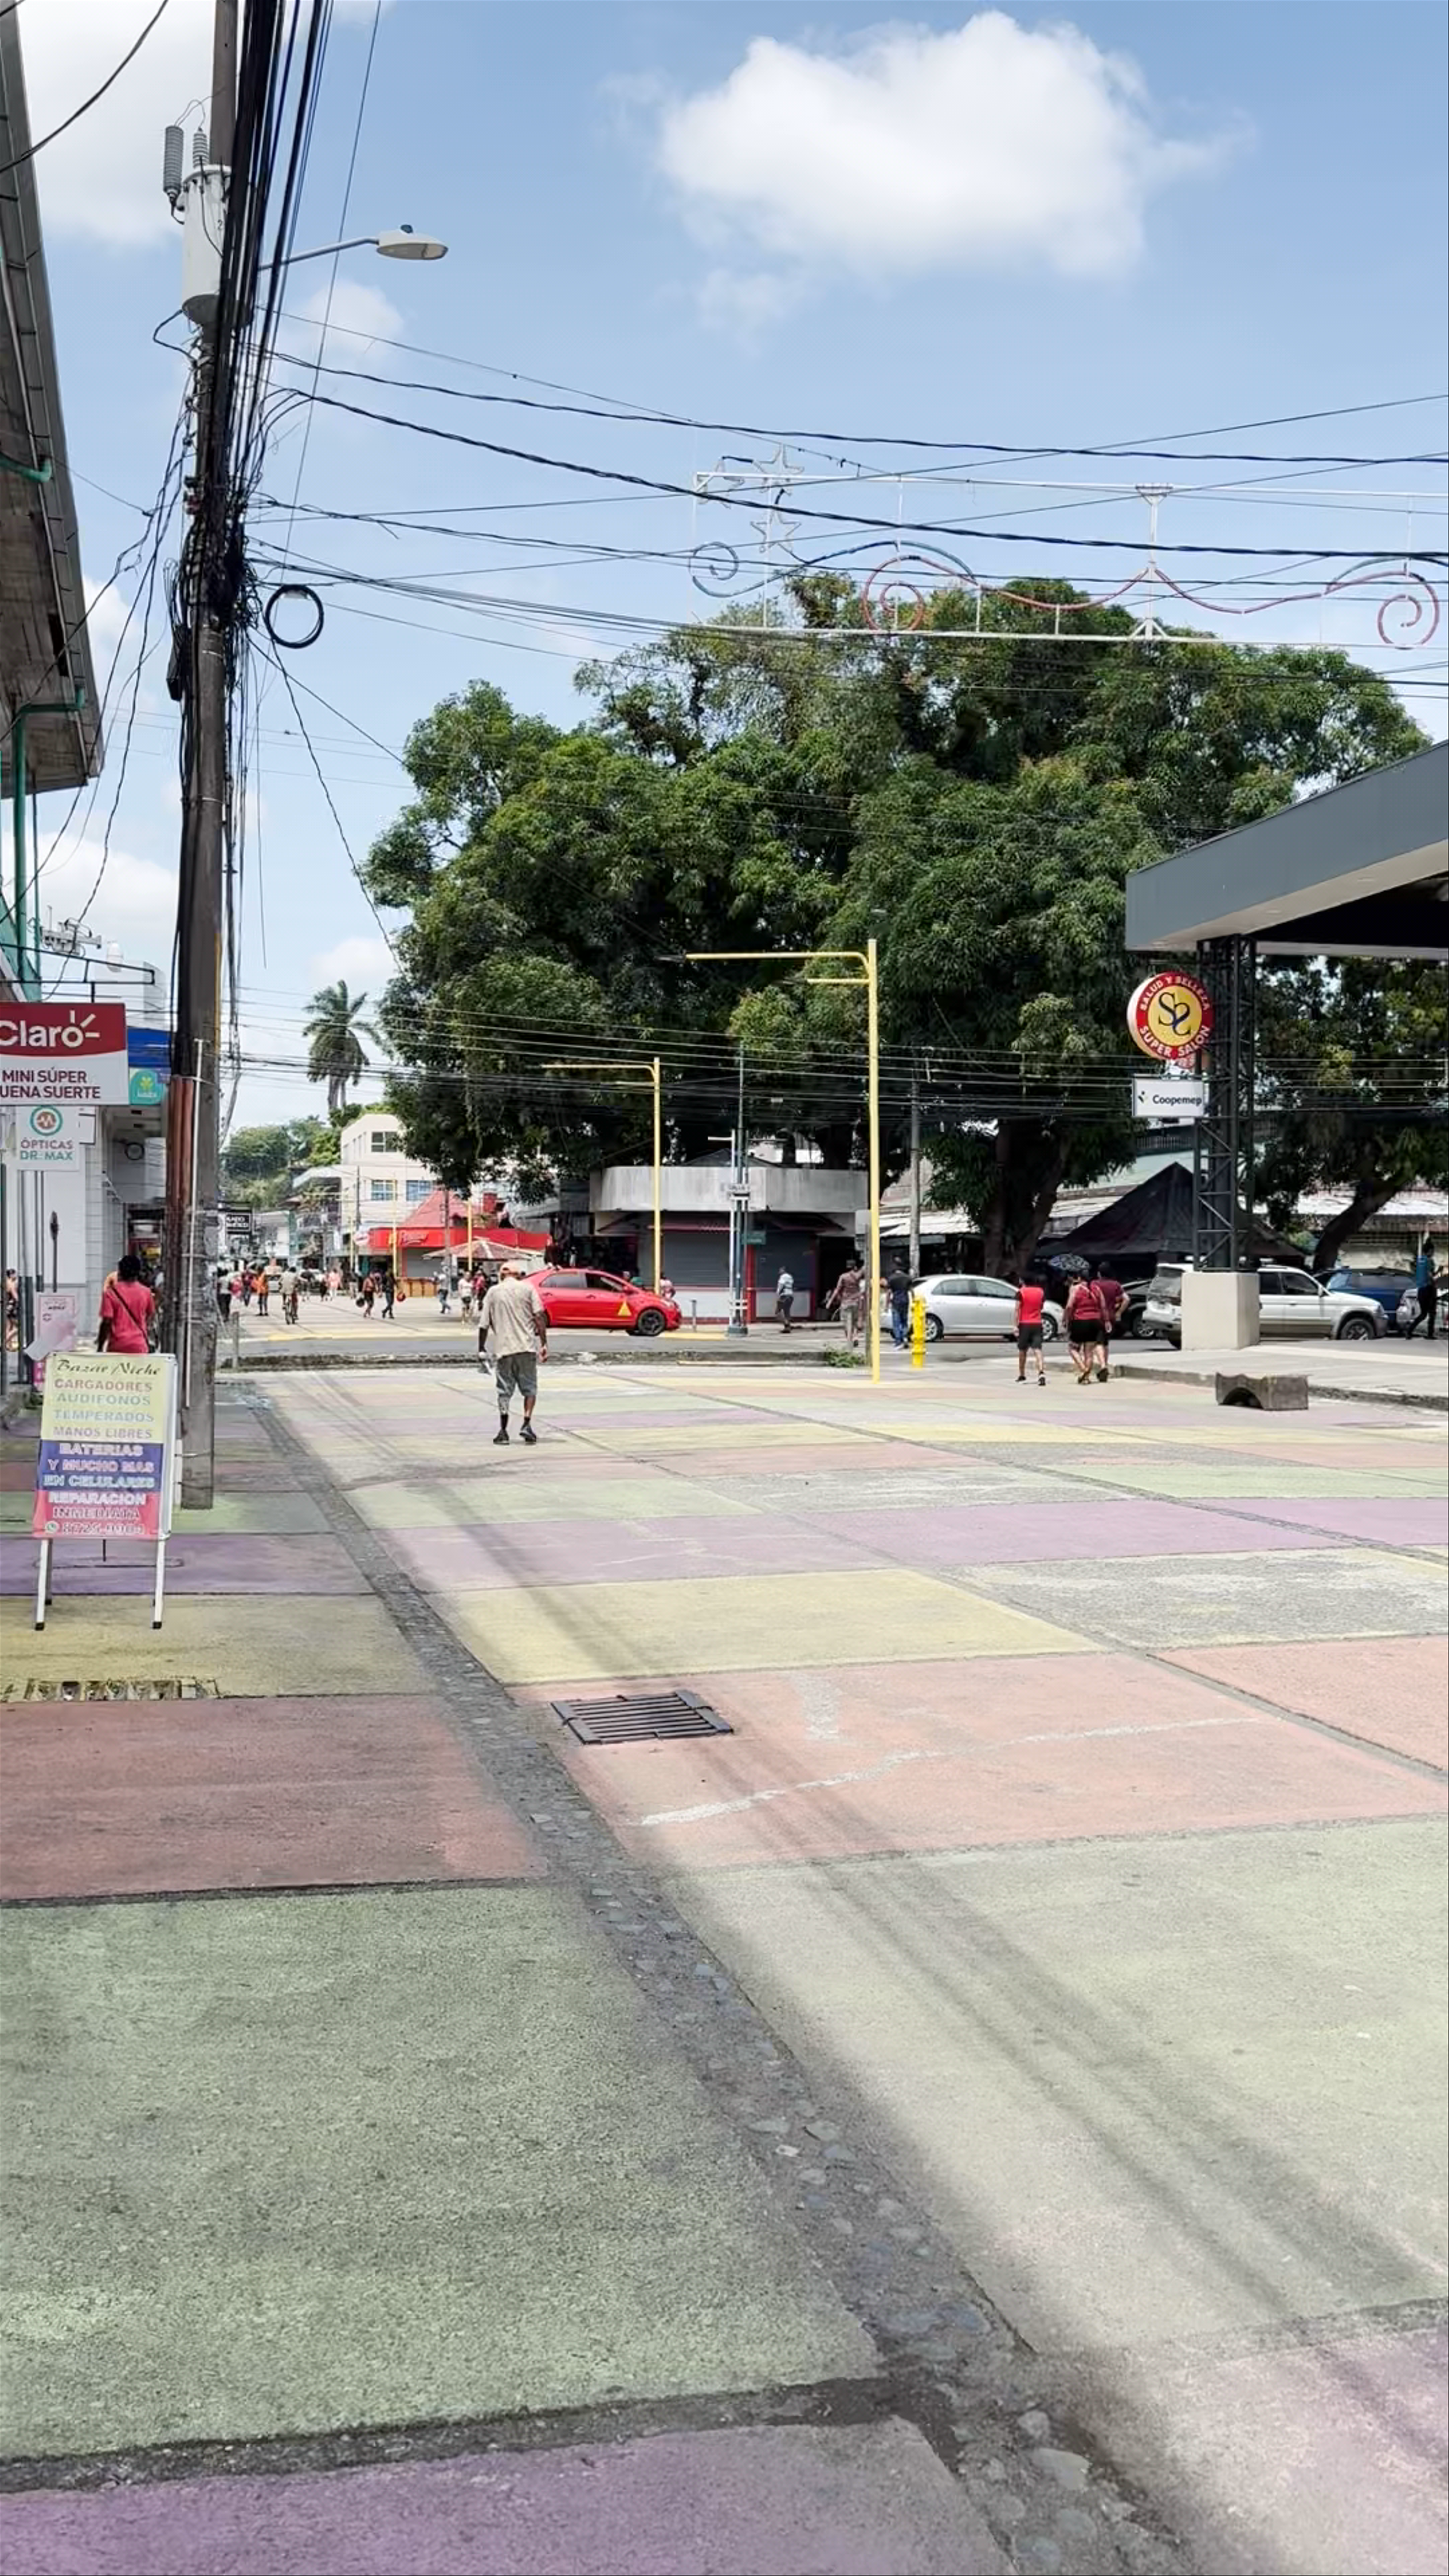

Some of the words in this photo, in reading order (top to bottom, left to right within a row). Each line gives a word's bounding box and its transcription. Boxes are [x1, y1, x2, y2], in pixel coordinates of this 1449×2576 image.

[1140, 980, 1164, 1011] SALUD
[0, 1020, 84, 1048] Claro
[1140, 1026, 1172, 1057] SUPER
[2, 1070, 34, 1083] MINI
[37, 1066, 87, 1083] SÚPER
[0, 1085, 41, 1098] UENA
[43, 1085, 101, 1099] SUERTE
[1152, 1095, 1202, 1107] Coopemep
[45, 1151, 73, 1160] MAX
[57, 1359, 109, 1373] Bazar
[54, 1378, 153, 1392] CARGADORES
[57, 1393, 151, 1406] AUDIFONOS
[54, 1410, 154, 1423] TEMPERADOS
[53, 1426, 101, 1437] MANOS
[105, 1428, 153, 1439] LIBRES
[59, 1443, 144, 1456] BATERIAS
[48, 1459, 59, 1471] Y
[62, 1459, 118, 1472] MUCHO
[122, 1461, 154, 1473] MAS
[43, 1474, 65, 1486] EN
[68, 1475, 155, 1488] CELULARES
[48, 1492, 146, 1505] REPARACION
